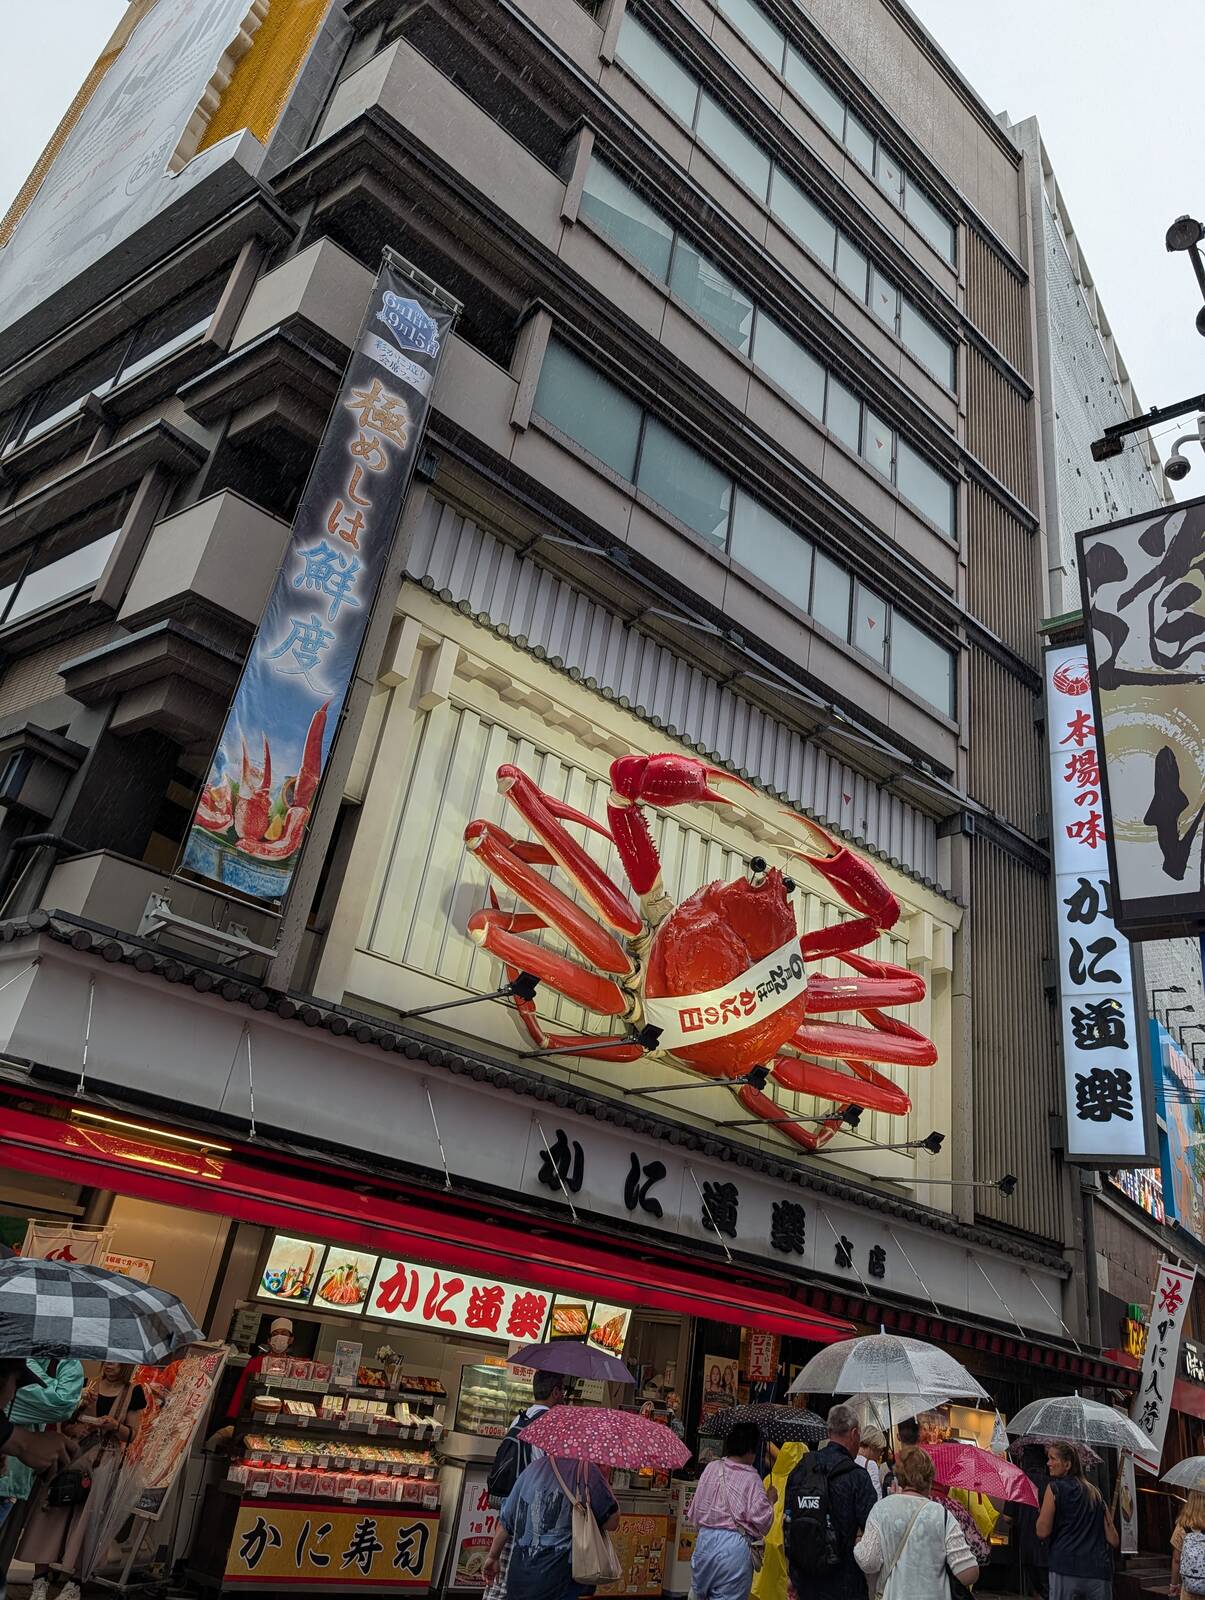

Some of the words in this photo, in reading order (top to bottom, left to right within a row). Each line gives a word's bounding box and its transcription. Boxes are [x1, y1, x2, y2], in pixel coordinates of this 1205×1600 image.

[264, 378, 408, 696] 極めしは鮮度
[1059, 709, 1105, 849] 本場の味
[512, 1366, 534, 1378] 販売中
[751, 1335, 766, 1375] ジュース
[1138, 1277, 1185, 1436] 活かに入荷
[797, 1495, 820, 1509] VANS
[239, 1515, 431, 1578] かに寿司
